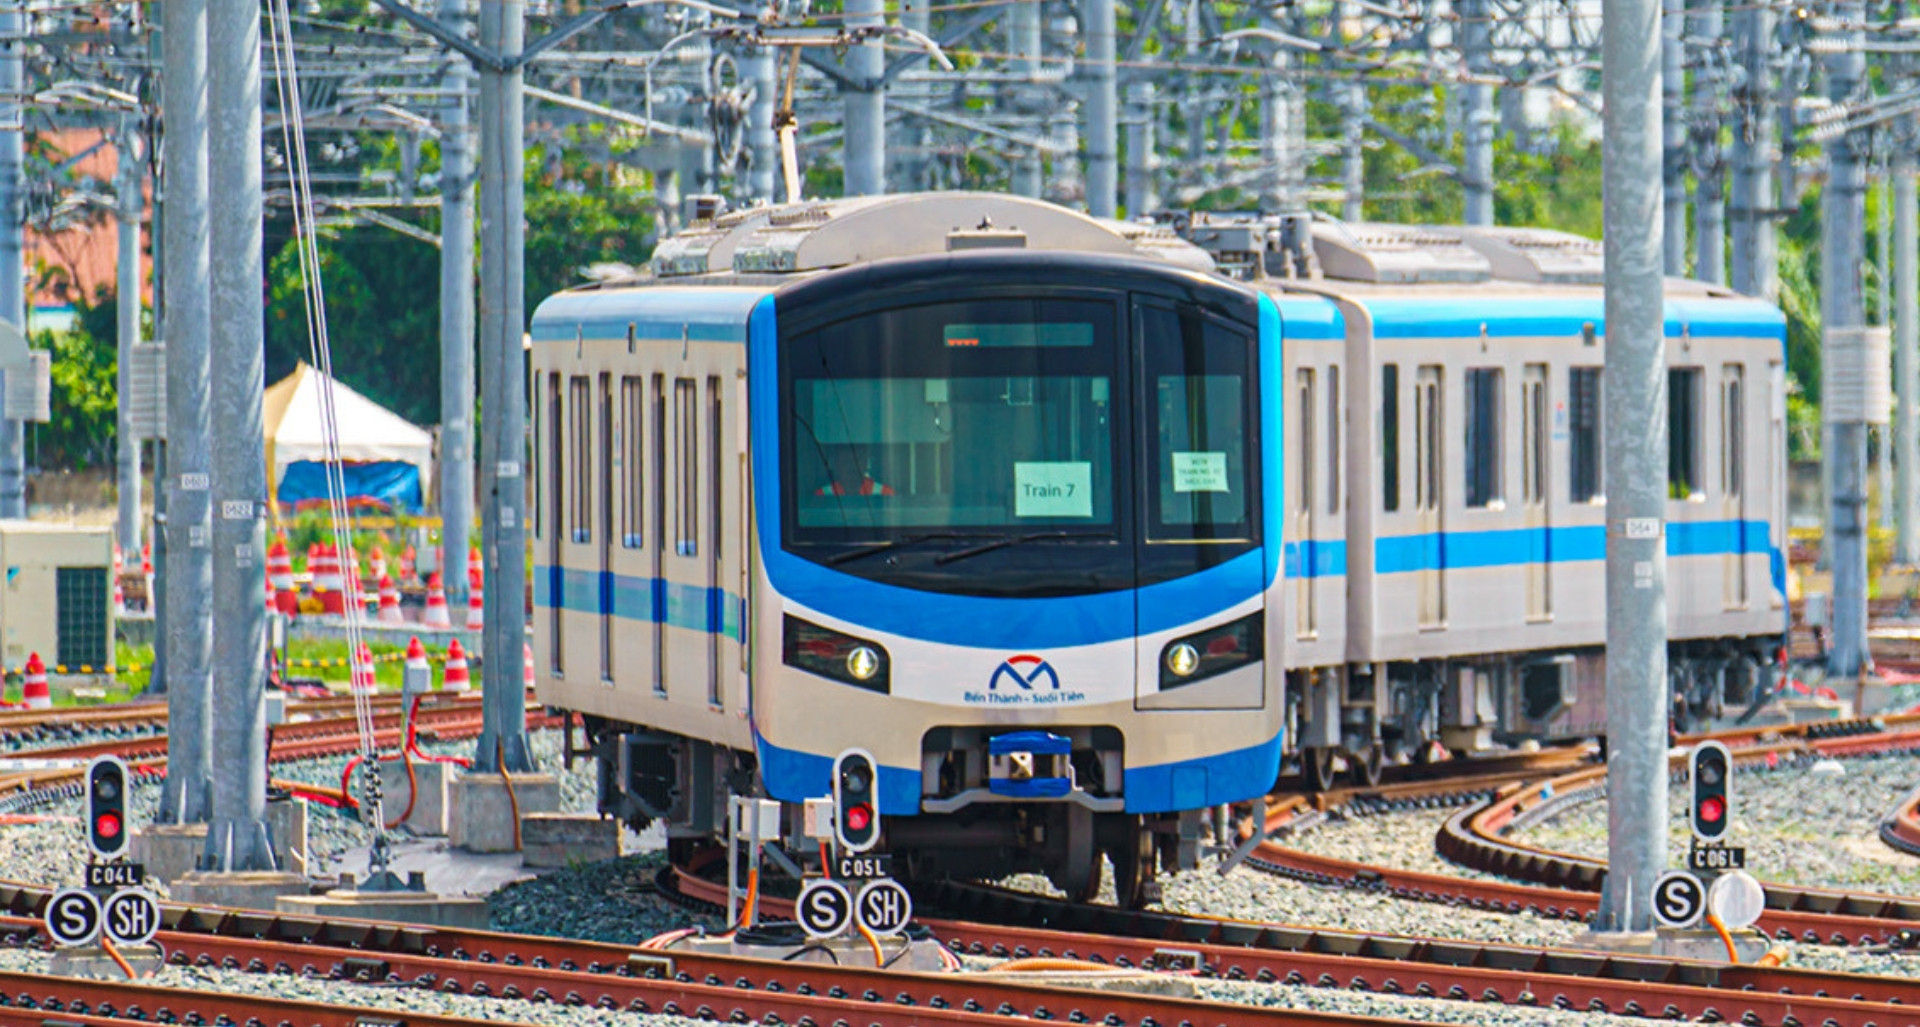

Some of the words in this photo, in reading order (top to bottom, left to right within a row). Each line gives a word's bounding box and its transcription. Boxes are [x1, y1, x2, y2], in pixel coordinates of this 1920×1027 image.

[1024, 484, 1062, 498] Train
[1066, 484, 1076, 498] 7
[92, 867, 137, 885] C04L
[841, 859, 886, 877] C05L
[1695, 849, 1740, 868] C06L
[60, 898, 87, 936] S
[115, 899, 149, 936] SH
[811, 890, 838, 928] S
[867, 889, 899, 927] SH
[1664, 881, 1692, 918] S
